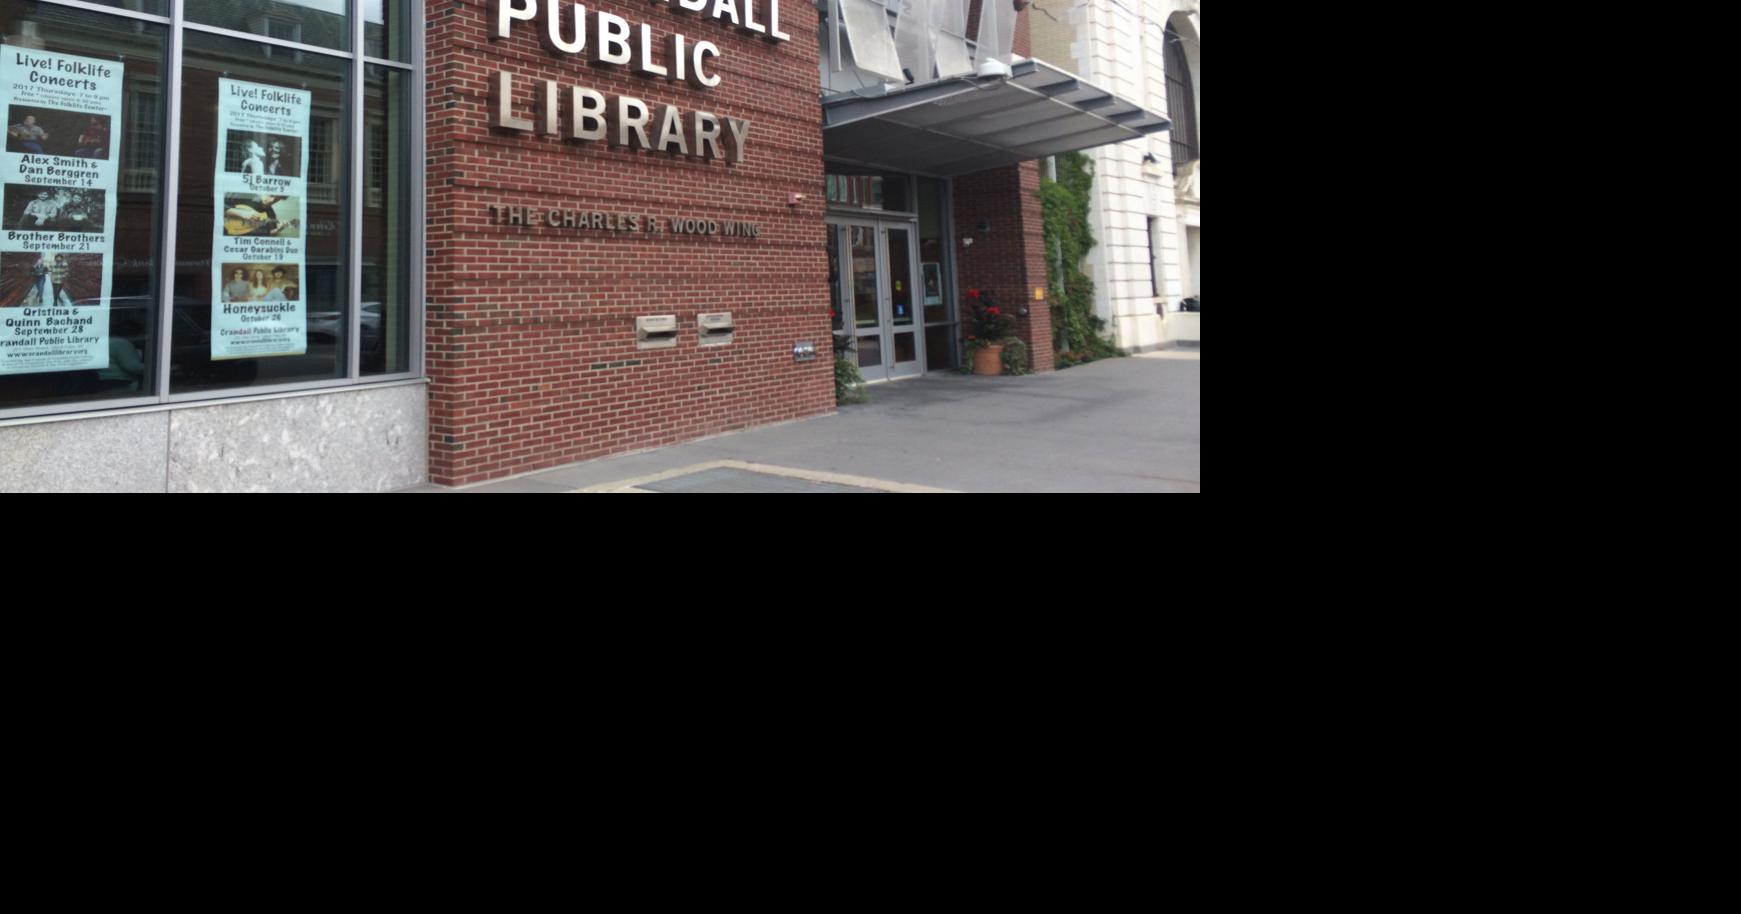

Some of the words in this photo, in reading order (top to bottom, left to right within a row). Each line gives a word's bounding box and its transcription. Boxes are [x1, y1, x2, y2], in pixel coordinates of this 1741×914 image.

[666, 0, 790, 41] ALL
[495, 0, 722, 87] PUBLIC
[16, 53, 52, 69] Live!
[57, 59, 111, 78] Folklife
[30, 71, 97, 91] Concerts
[231, 84, 258, 99] Live!
[261, 89, 303, 105] Folklife
[241, 99, 292, 116] Concerts
[497, 71, 751, 162] LIBRARY
[21, 154, 49, 165] Alex
[53, 157, 88, 168] Smith
[19, 164, 43, 174] Dan
[46, 166, 100, 179] Berggren
[24, 175, 76, 186] September
[81, 178, 93, 186] 14
[256, 175, 292, 186] Barrow
[490, 204, 538, 226] THE
[547, 208, 639, 231] CHARLES
[646, 214, 664, 232] R.
[670, 216, 717, 235] WOOD
[723, 219, 762, 238] WING
[8, 231, 55, 242] Brother
[58, 232, 105, 243] Brothers
[233, 237, 252, 246] Tim
[254, 237, 286, 246] Connell
[22, 241, 75, 251] September
[79, 242, 90, 250] 21
[23, 308, 70, 316] Qristina
[223, 302, 296, 314] Honeysuckle
[5, 318, 41, 328] Quinn
[46, 316, 93, 326] Bachand
[14, 326, 69, 336] September
[72, 326, 84, 334] 28
[220, 328, 252, 336] Crandall
[39, 336, 65, 346] Public
[67, 335, 100, 344] Library
